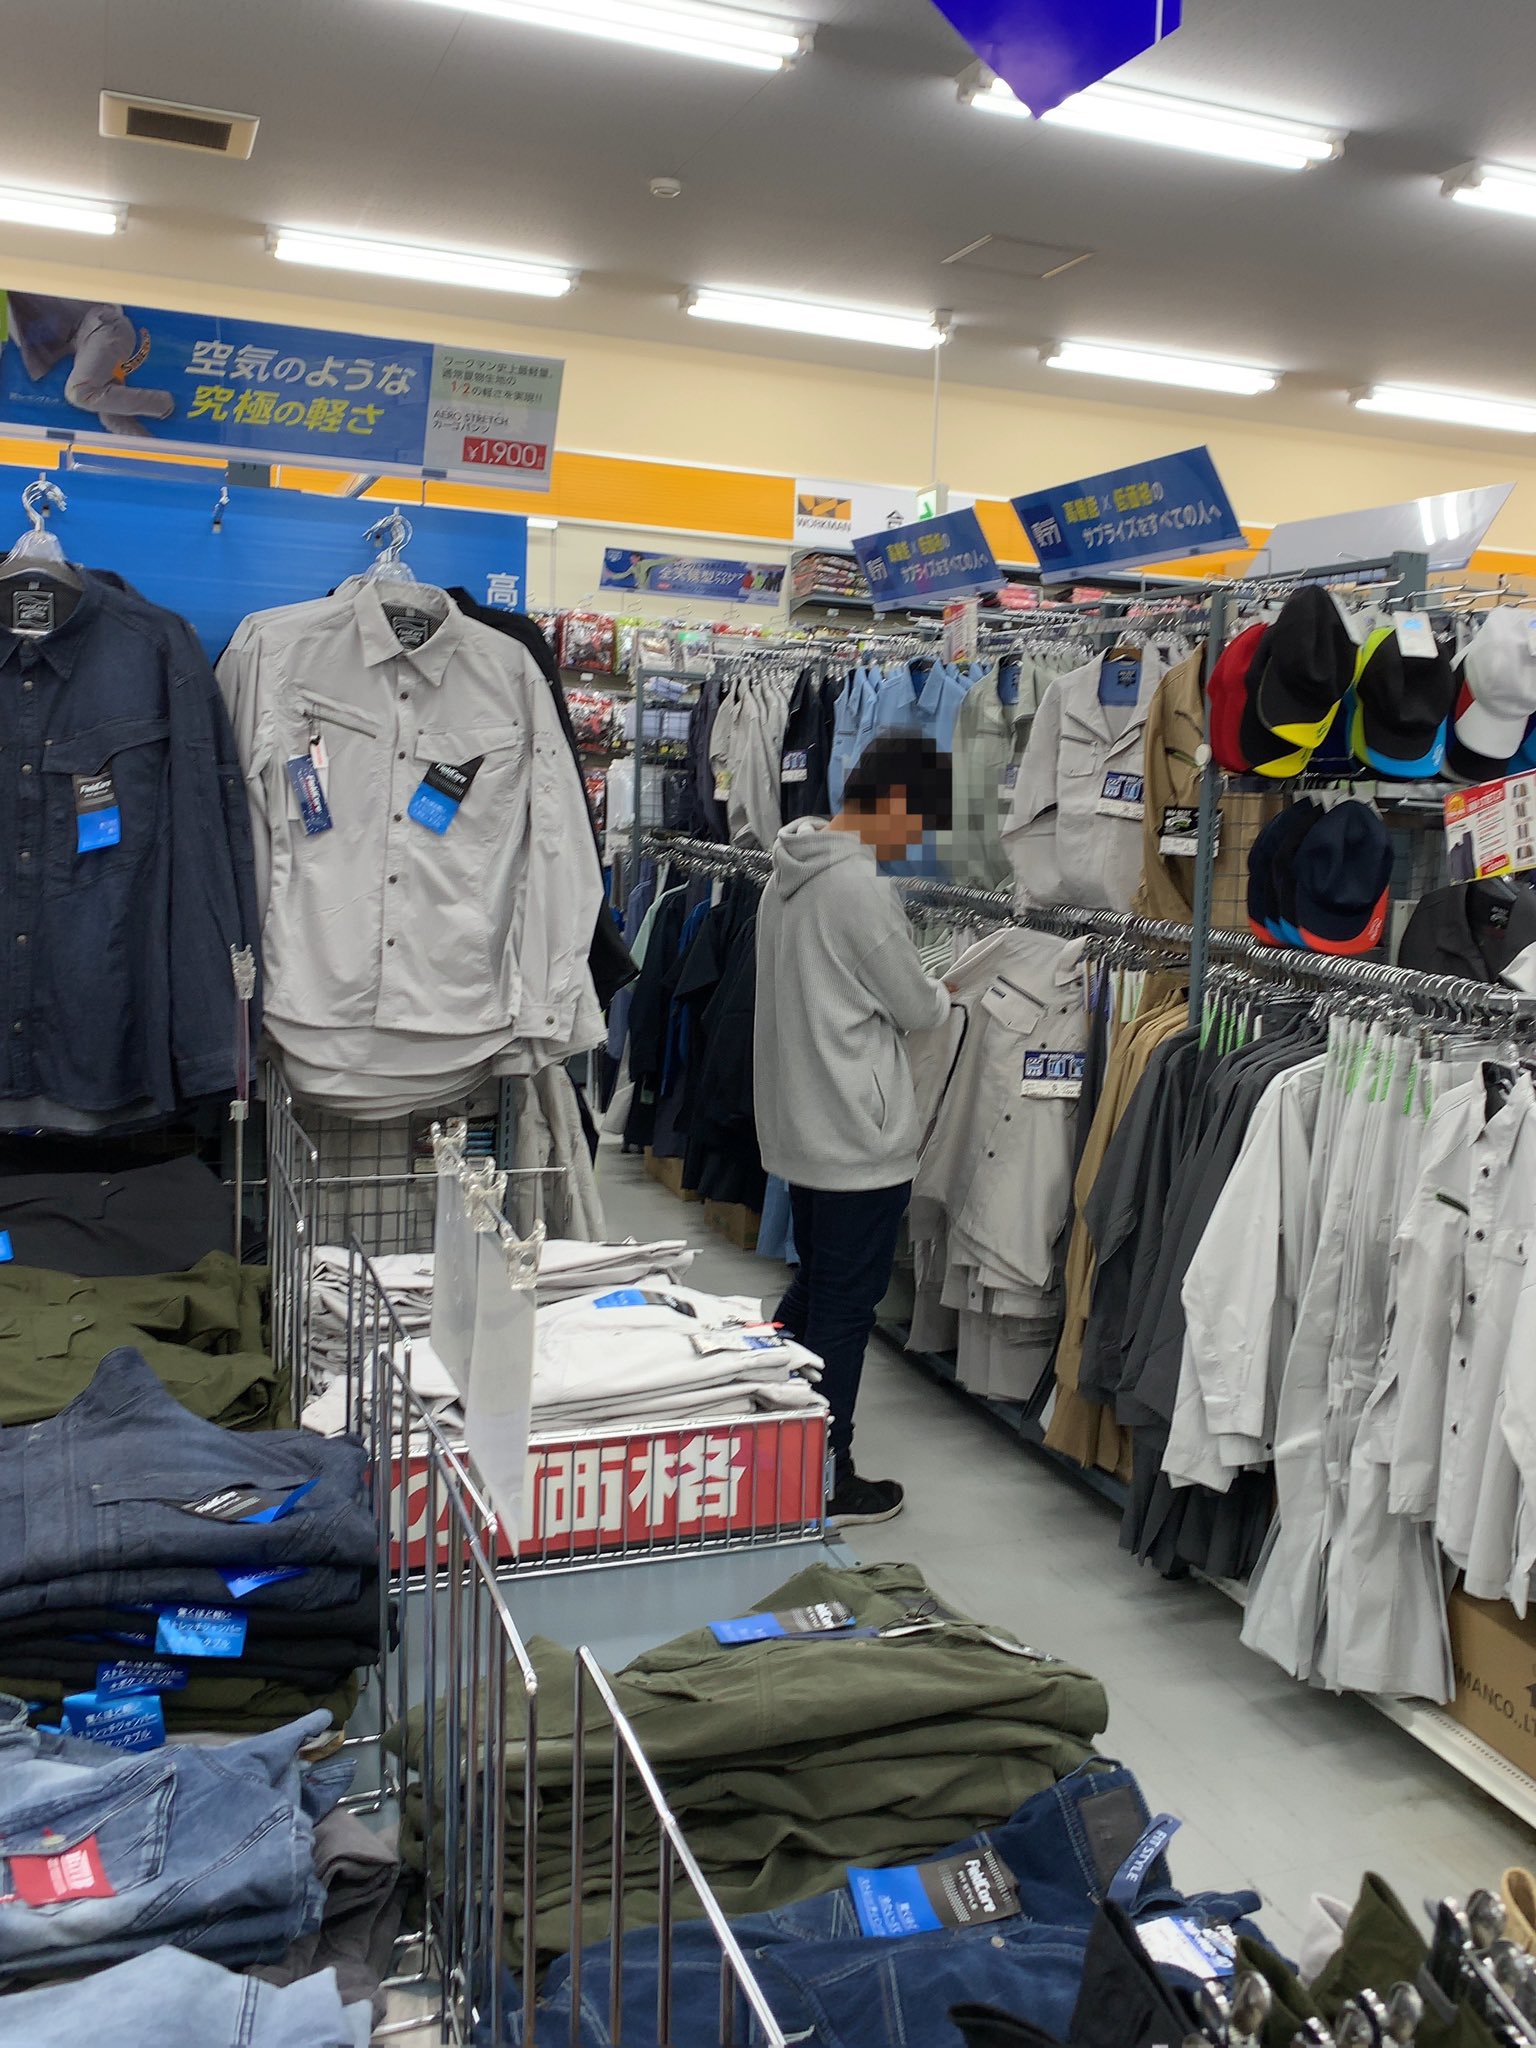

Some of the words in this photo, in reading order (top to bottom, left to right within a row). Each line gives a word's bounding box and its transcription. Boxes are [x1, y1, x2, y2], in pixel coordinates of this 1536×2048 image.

[184, 338, 418, 396] 空気のような
[187, 384, 385, 436] 究極の軽さ
[796, 516, 852, 533] WORKMAN
[1125, 1844, 1156, 1883] STYLE
